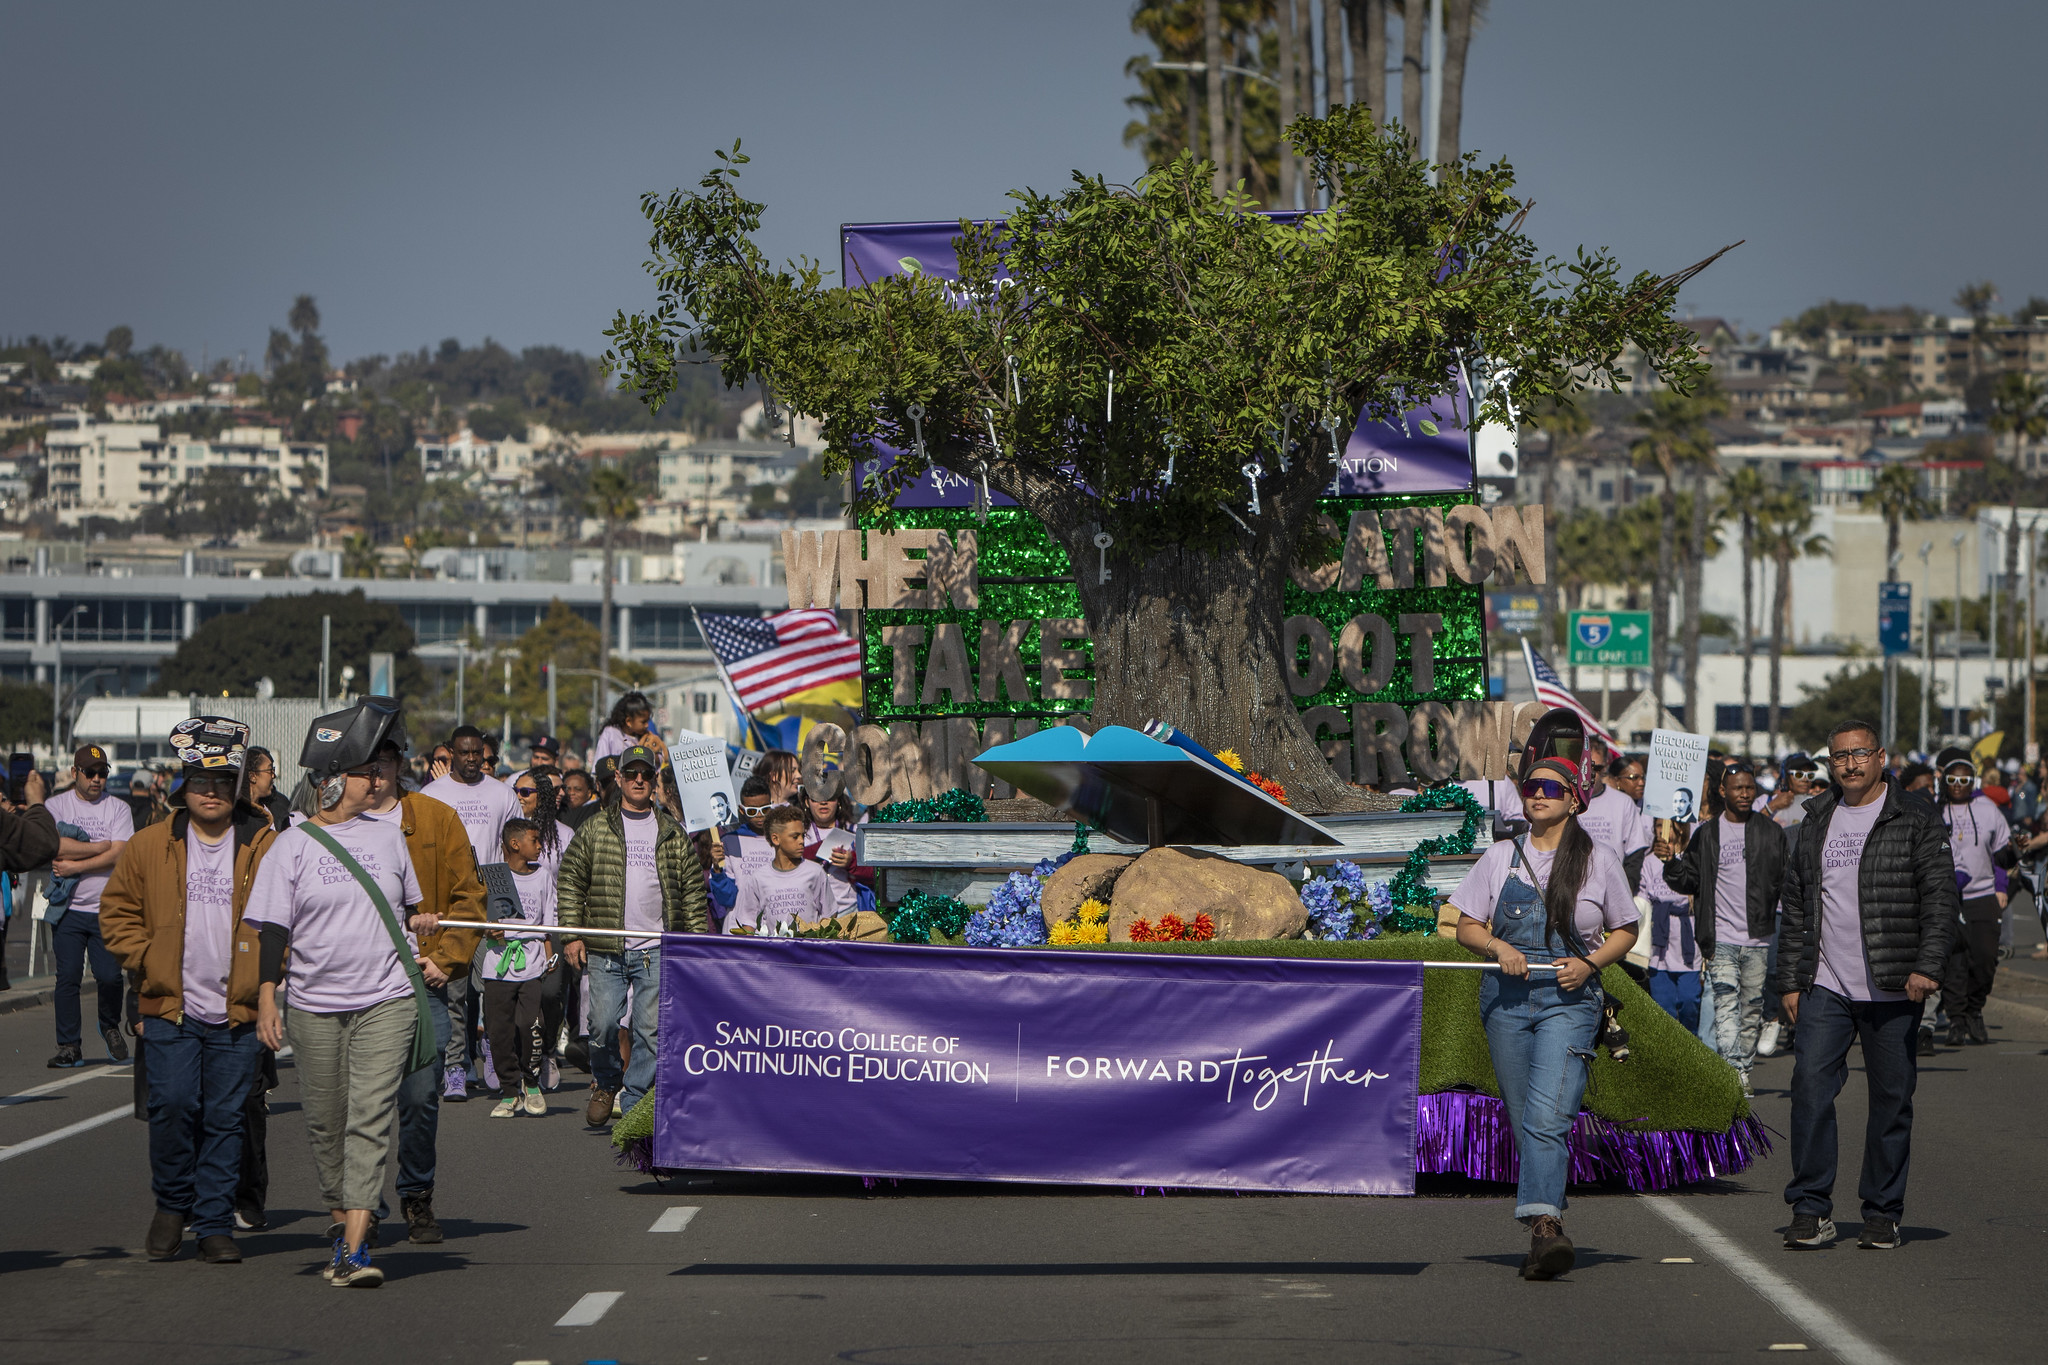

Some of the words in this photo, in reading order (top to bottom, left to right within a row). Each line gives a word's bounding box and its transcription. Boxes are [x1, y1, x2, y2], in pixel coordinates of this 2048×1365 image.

[1339, 457, 1398, 474] ATION
[781, 529, 978, 609] WHEN
[1589, 626, 1601, 644] 5
[882, 618, 1091, 706] TAKE
[1284, 613, 1443, 697] OOT
[1654, 734, 1706, 752] BECOME...
[673, 744, 722, 761] BECOME...
[1655, 746, 1678, 758] WHO
[1679, 750, 1700, 762] YOU
[682, 761, 690, 772] A
[690, 756, 718, 770] ROLE
[1660, 759, 1690, 771] WANT
[683, 768, 721, 783] MODEL
[1660, 770, 1672, 781] TO
[1674, 772, 1689, 783] BE
[1828, 839, 1863, 849] COLLEGE
[1824, 849, 1863, 858] CONTINU
[1826, 858, 1860, 868] EDUCATI
[715, 1021, 760, 1046] SAN
[765, 1025, 834, 1049] DIEGO
[838, 1028, 927, 1054] COLLEGE
[932, 1036, 960, 1055] OF
[683, 1044, 841, 1078] CONTINUING
[847, 1054, 990, 1085] EDUCATION
[1047, 1055, 1221, 1083] FORWARD
